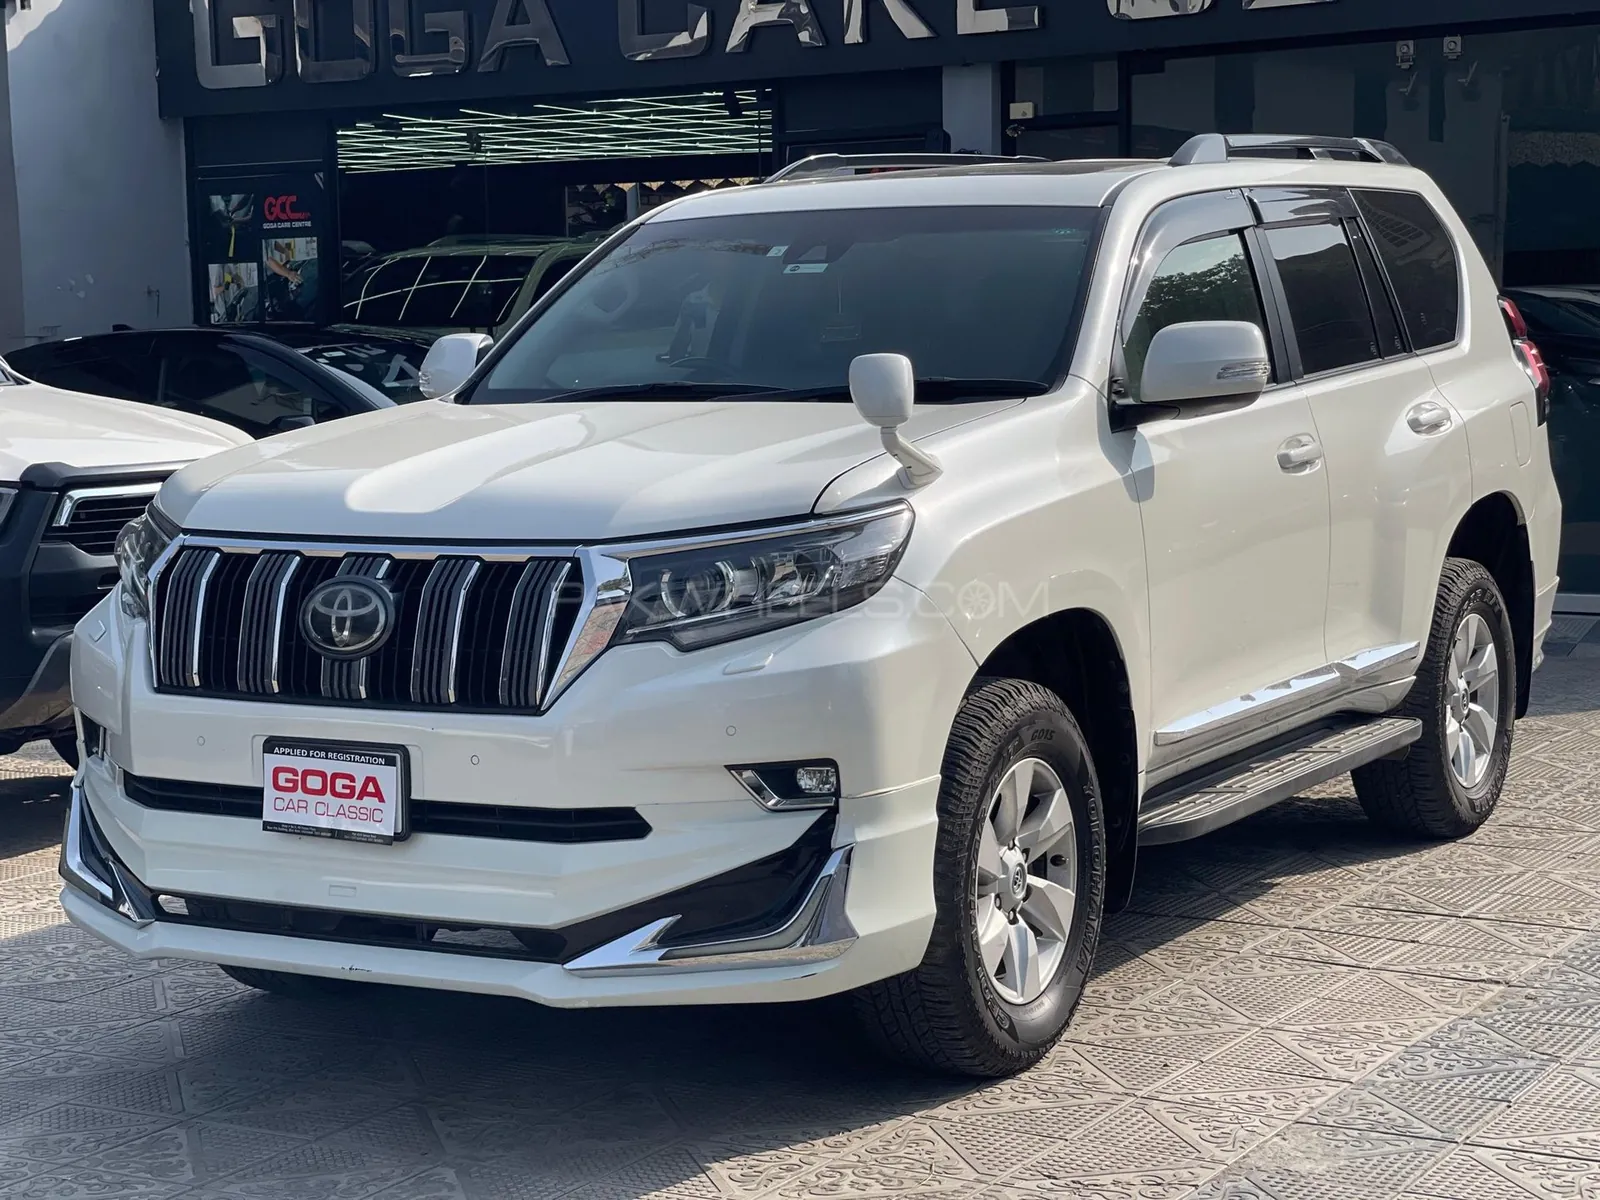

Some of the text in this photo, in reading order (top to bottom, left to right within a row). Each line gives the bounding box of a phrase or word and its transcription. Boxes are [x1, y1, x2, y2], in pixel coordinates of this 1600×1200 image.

[192, 0, 571, 89] GOGA
[264, 195, 306, 220] GCC
[273, 747, 386, 765] APPLIED FOR REGISTRATION
[272, 766, 386, 803] GOGA
[273, 797, 384, 823] CAR CLASSIC
[1076, 780, 1104, 975] YOKOHAMA
